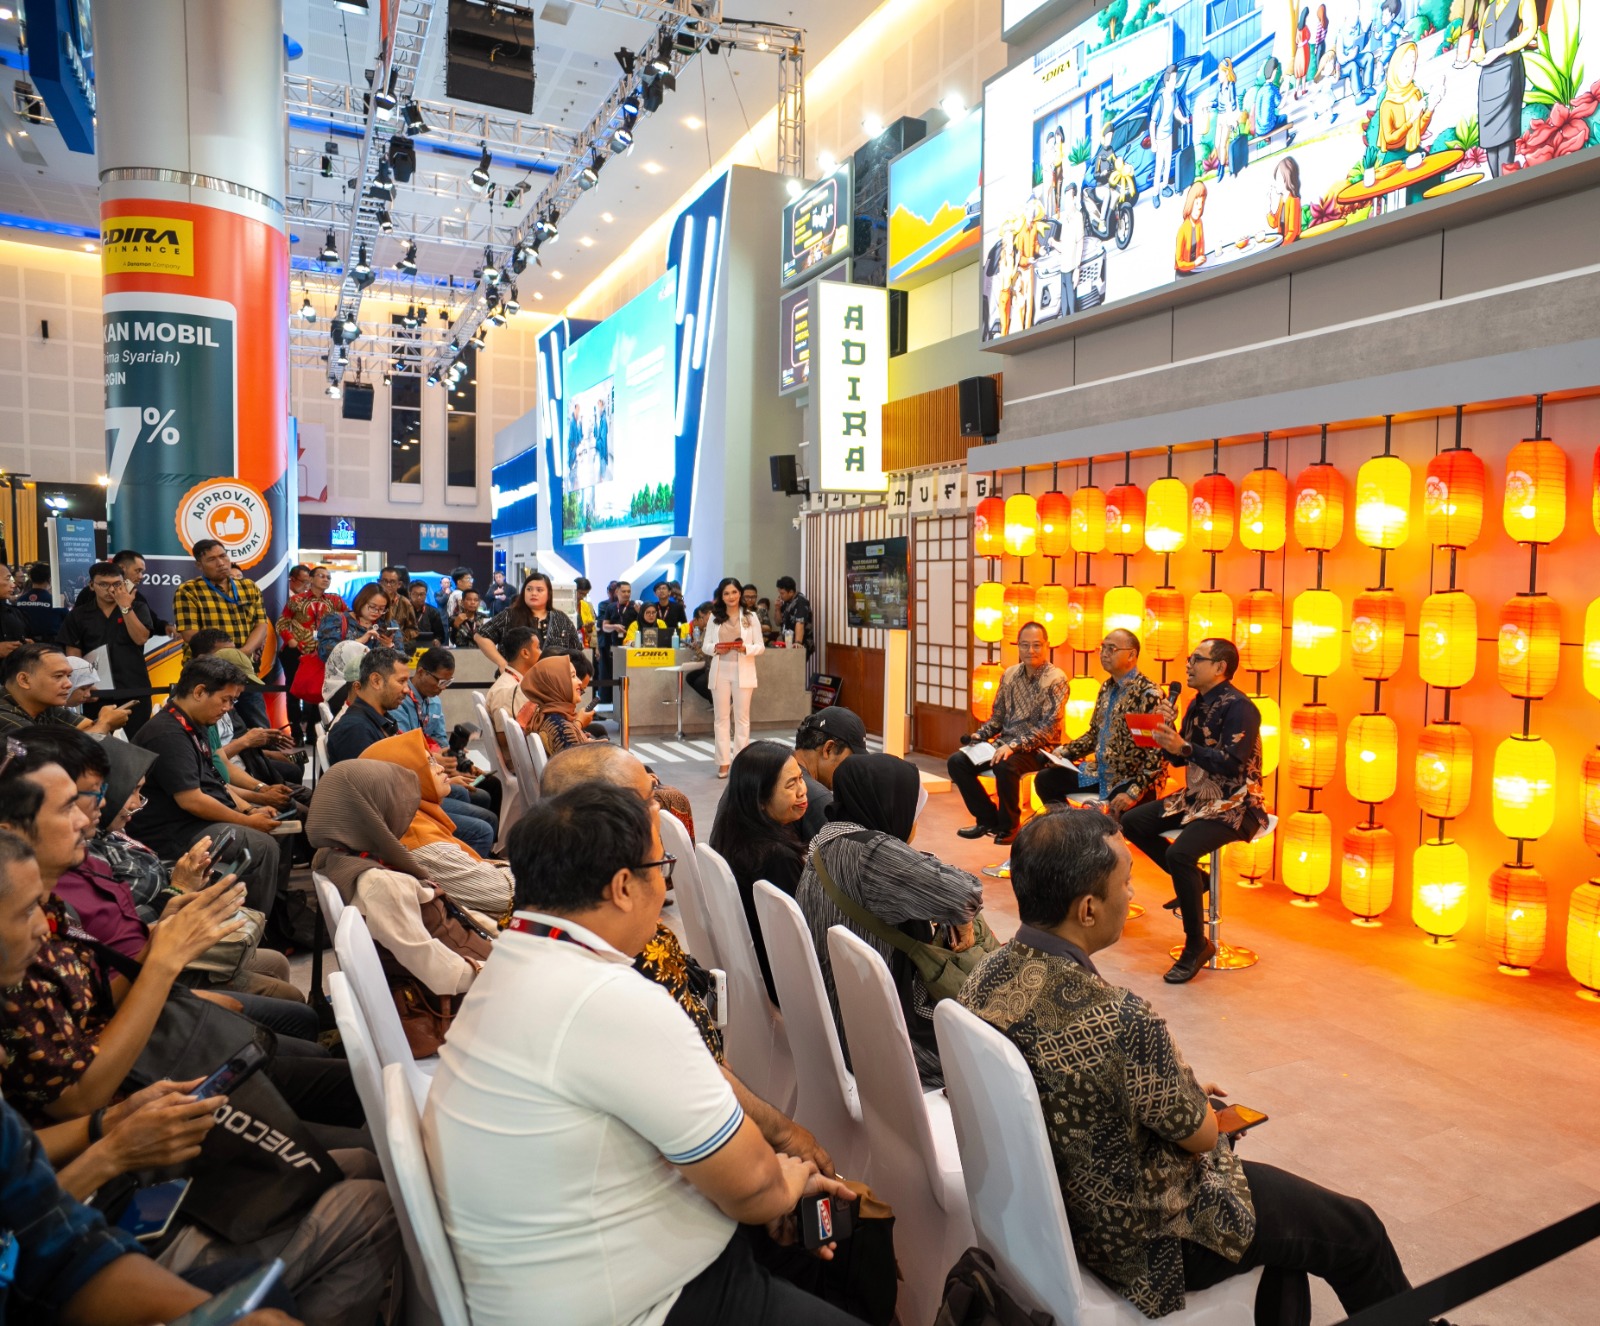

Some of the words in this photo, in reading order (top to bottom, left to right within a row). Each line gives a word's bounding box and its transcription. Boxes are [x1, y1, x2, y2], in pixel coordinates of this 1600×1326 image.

[134, 322, 220, 348] MOBIL
[122, 350, 181, 366] Syariah)
[841, 304, 867, 472] ADIRA
[193, 490, 256, 520] APPROVAL
[142, 573, 182, 586] 2026
